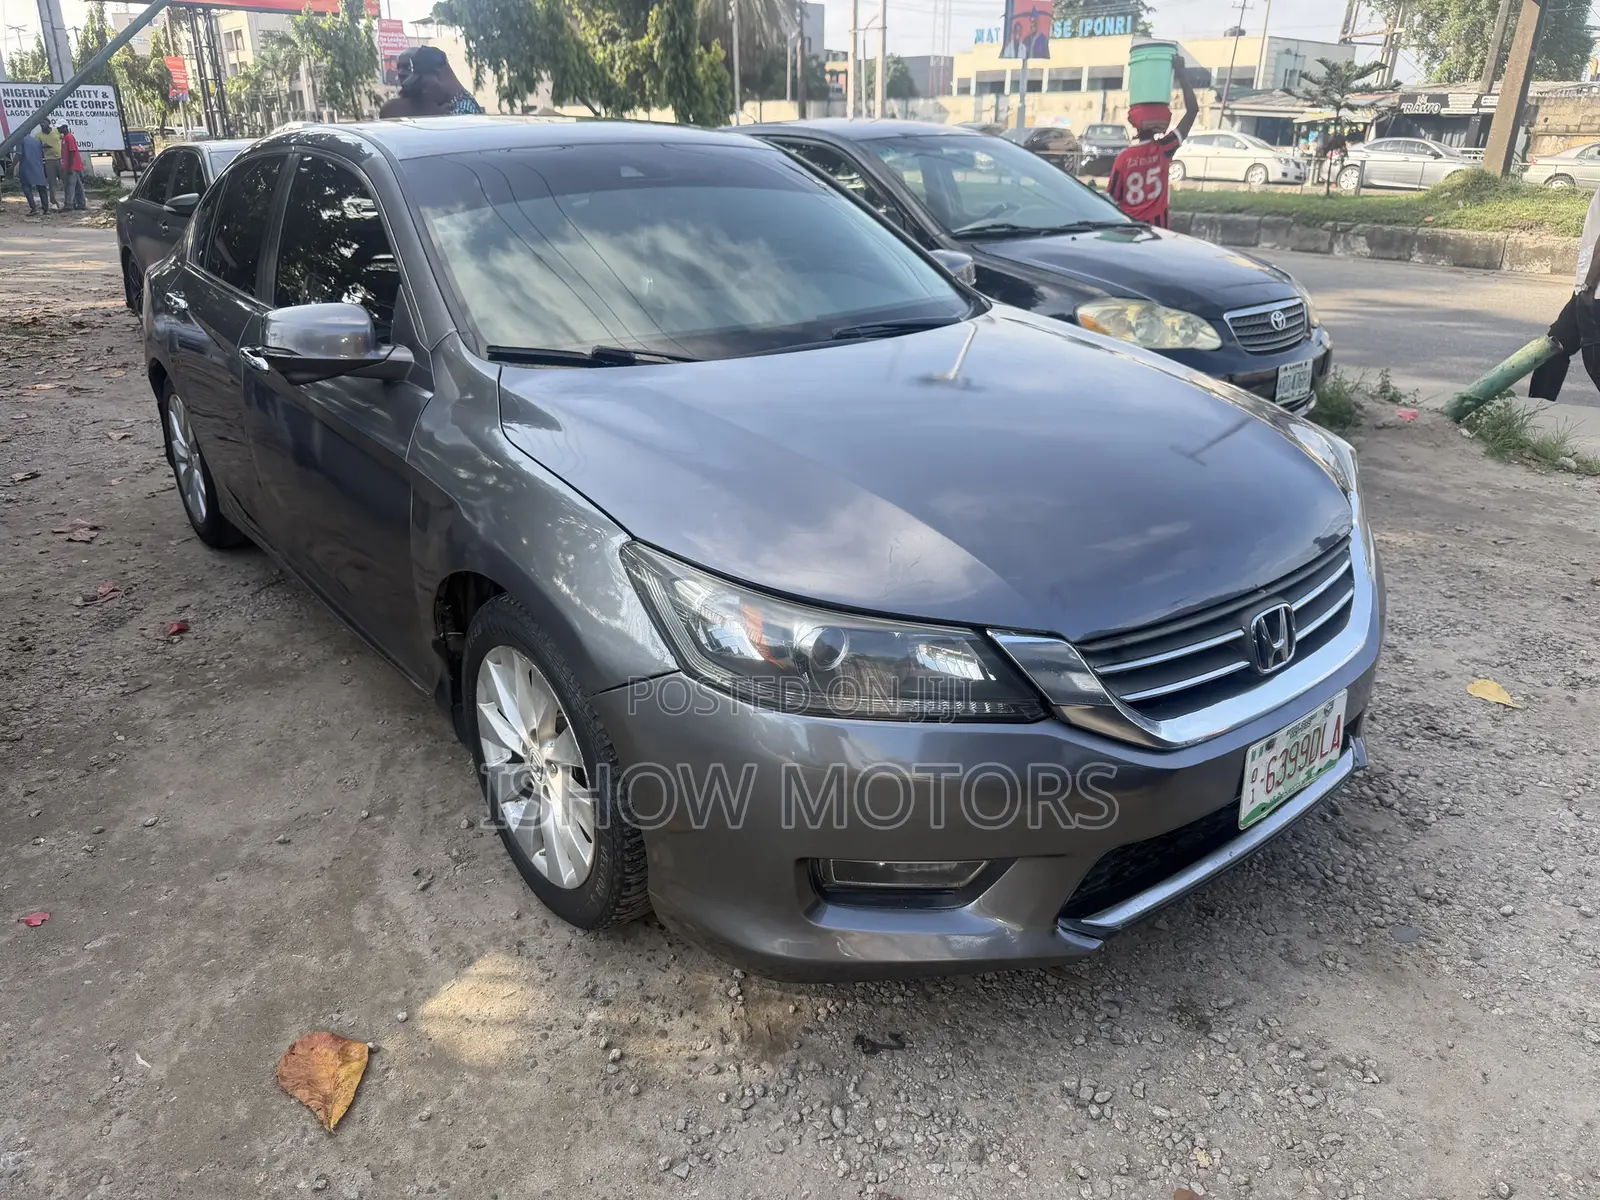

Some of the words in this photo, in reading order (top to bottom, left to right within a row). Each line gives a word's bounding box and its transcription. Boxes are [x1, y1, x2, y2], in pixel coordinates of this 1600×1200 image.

[1079, 15, 1133, 37] IPONRI
[2, 88, 47, 98] NIGERIA
[101, 91, 109, 99] &
[3, 99, 33, 108] CIVIL
[80, 100, 115, 110] CORPS
[6, 109, 30, 117] LAGOS
[65, 110, 85, 118] AREA
[85, 110, 119, 118] COMMAND
[1126, 166, 1162, 206] 85
